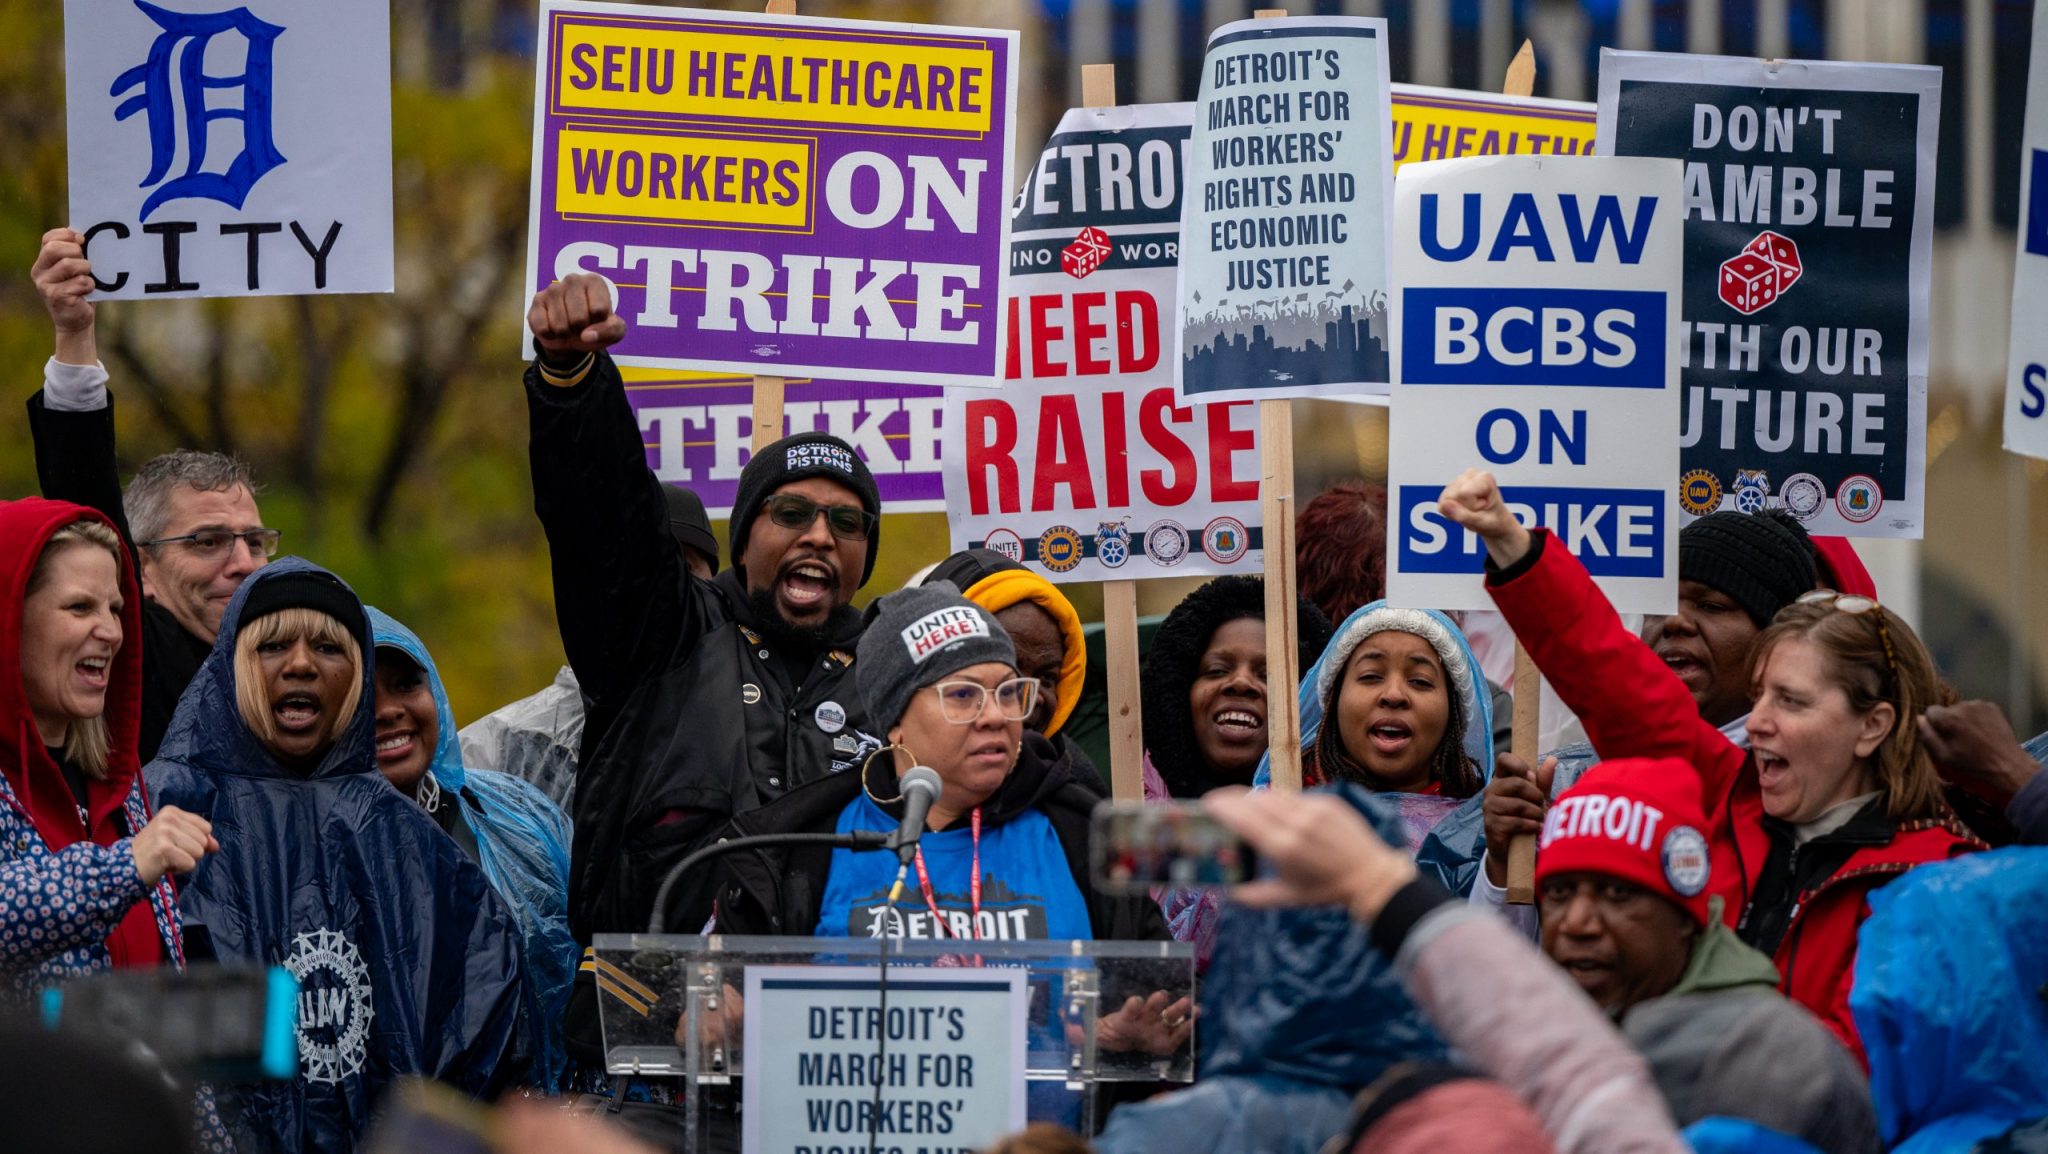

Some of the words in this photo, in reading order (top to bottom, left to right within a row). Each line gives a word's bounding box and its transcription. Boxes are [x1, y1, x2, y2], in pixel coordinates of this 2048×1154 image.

[569, 43, 675, 95] SEIU
[688, 50, 983, 114] HEALTHCARE
[1214, 49, 1340, 90] DETROIT'S
[1208, 93, 1290, 131] MARCH
[1299, 91, 1350, 121] FOR
[1692, 103, 1842, 154] DON'T
[1212, 131, 1342, 170] WORKERS'
[571, 147, 800, 207] WORKERS
[825, 150, 988, 234] ON
[1204, 175, 1293, 212] RIGHTS
[1300, 173, 1355, 204] AND
[1211, 213, 1348, 252] ECONOMIC
[1419, 193, 1659, 264] UAW
[81, 221, 343, 293] CITY
[1226, 255, 1330, 291] JUSTICE
[1434, 306, 1637, 368] BCBS
[1780, 325, 1883, 376] OUR
[965, 387, 1260, 516] RAISE
[1475, 408, 1587, 465] ON
[1690, 487, 1709, 497] UAW
[1051, 544, 1070, 554] UAW
[1409, 501, 1653, 558] SIKE
[909, 609, 975, 641] UNITE
[915, 620, 981, 656] HERE!
[298, 987, 347, 1029] UAW
[808, 1005, 965, 1041] DETROIT'S
[797, 1053, 906, 1087] MARCH
[916, 1054, 974, 1088] FOR
[806, 1099, 964, 1134] WORKERS'
